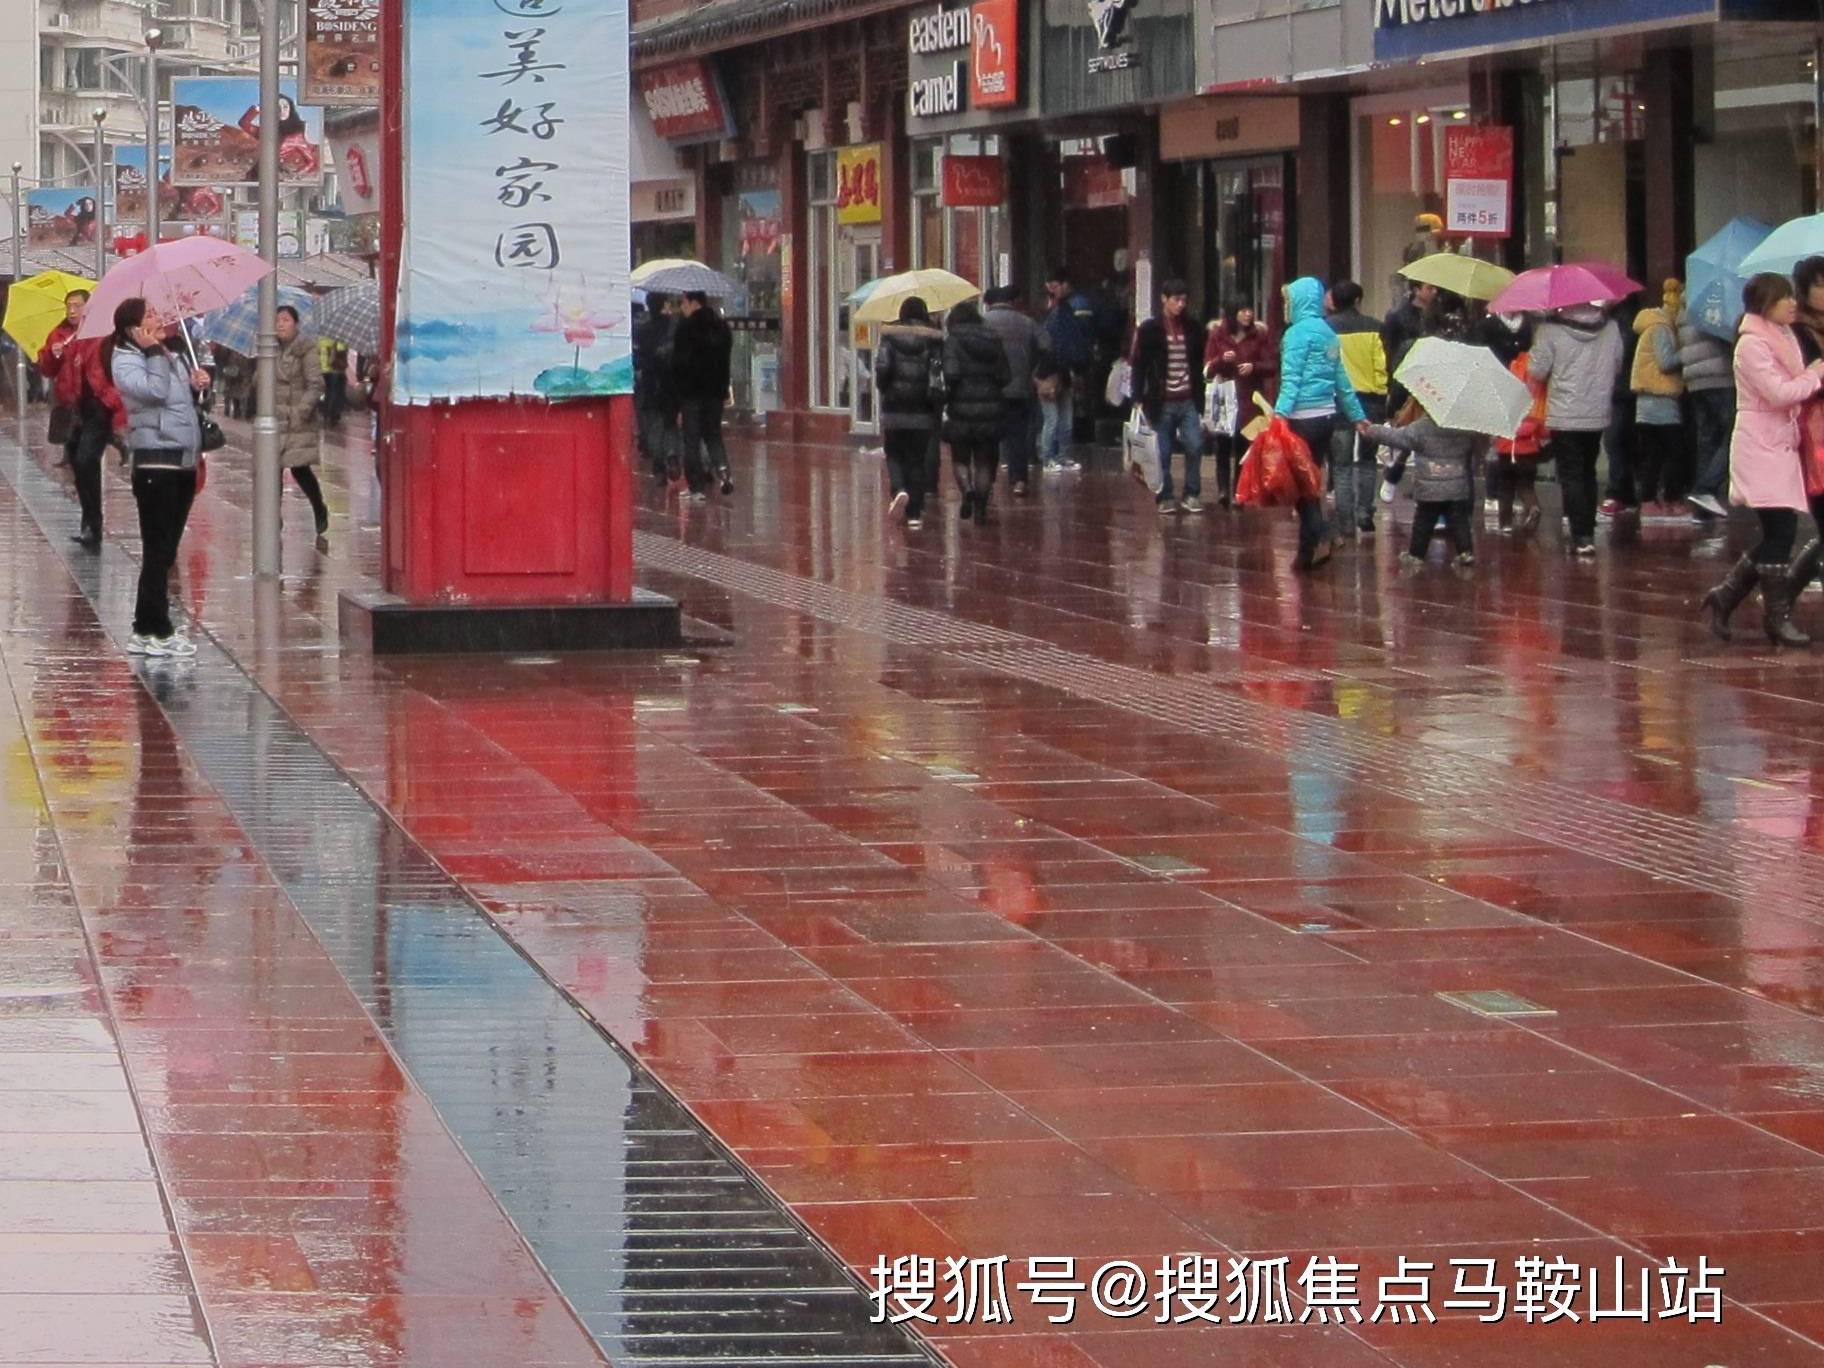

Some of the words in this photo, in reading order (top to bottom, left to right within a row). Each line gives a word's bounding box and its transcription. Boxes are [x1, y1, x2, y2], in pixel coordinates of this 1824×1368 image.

[316, 21, 377, 32] BOSIDENG
[909, 3, 972, 54] eastern
[911, 59, 959, 117] camel
